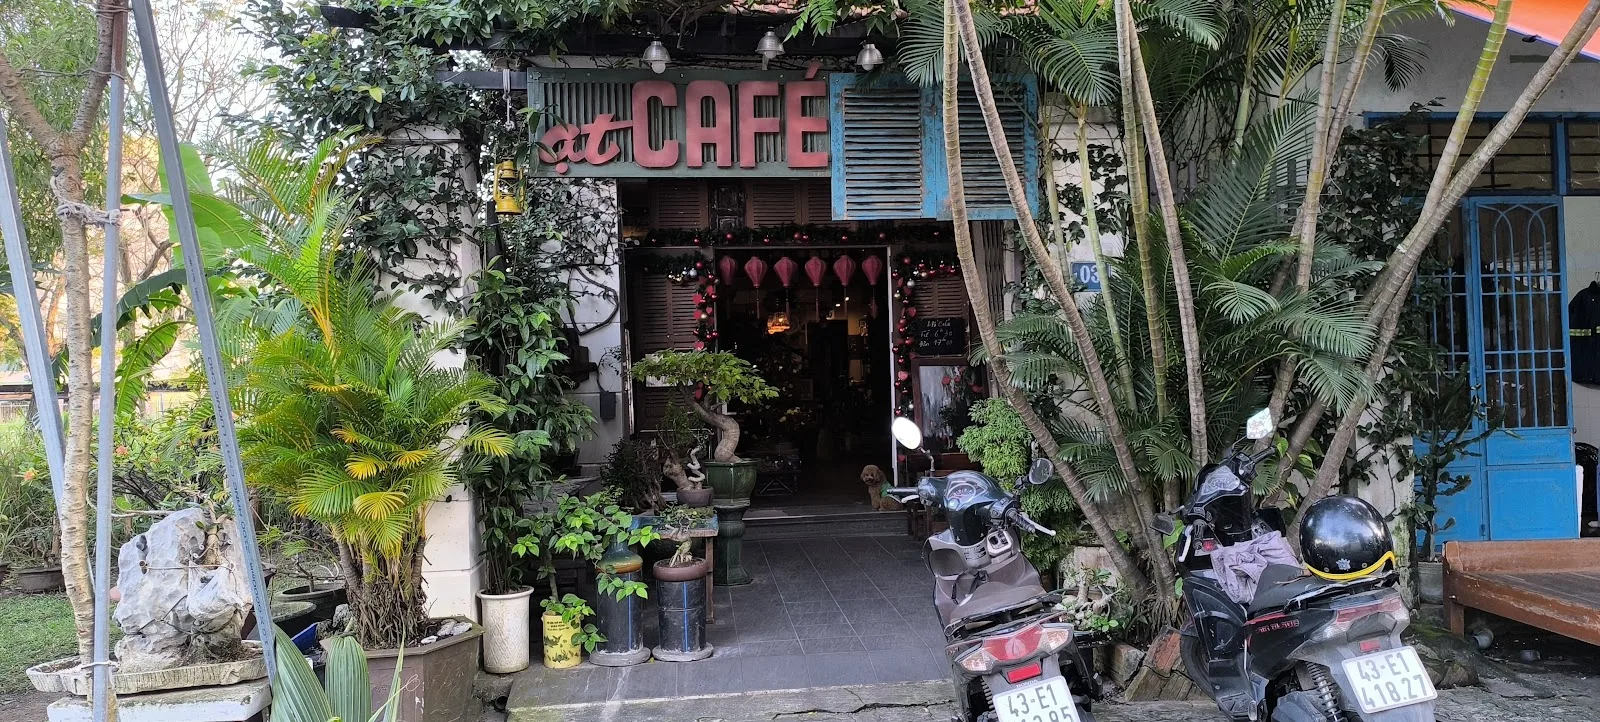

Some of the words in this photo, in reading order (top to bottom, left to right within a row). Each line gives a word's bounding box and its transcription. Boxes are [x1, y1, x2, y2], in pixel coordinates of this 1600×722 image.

[631, 60, 829, 169] CAFÉ
[1357, 652, 1409, 681] 43-E1
[1008, 683, 1058, 717] 43-E1
[1362, 674, 1428, 707] 418.27
